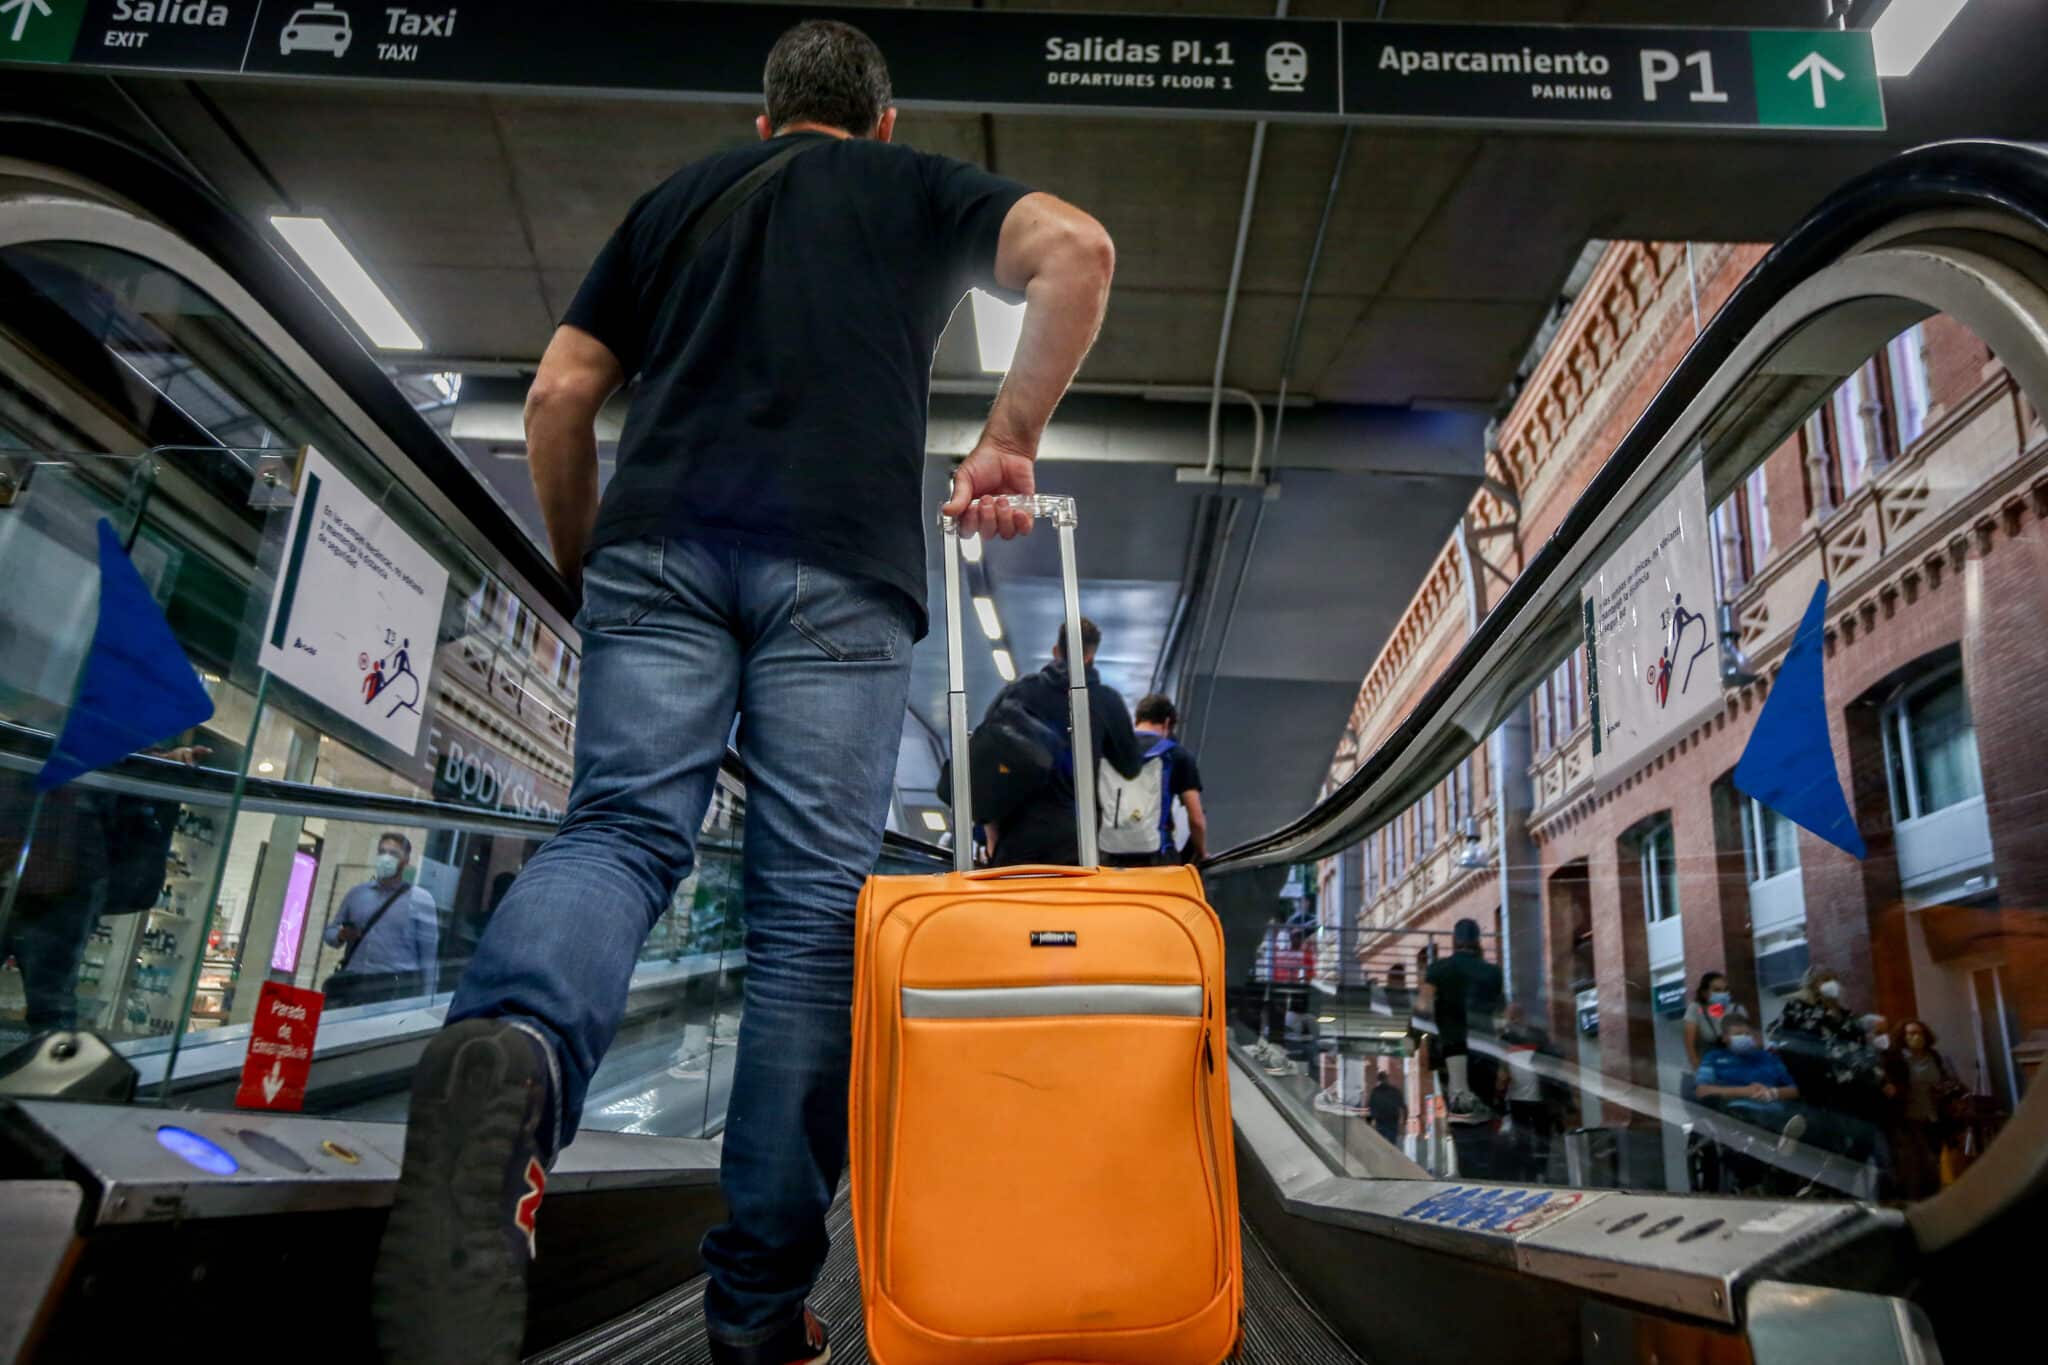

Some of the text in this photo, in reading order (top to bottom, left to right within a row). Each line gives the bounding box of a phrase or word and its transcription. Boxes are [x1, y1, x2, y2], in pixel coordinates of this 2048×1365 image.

[112, 0, 229, 26] Salida
[385, 8, 457, 38] Taxi
[104, 30, 149, 48] EXIT
[377, 43, 419, 61] TAXI
[1045, 37, 1234, 65] Salidas Pl.1
[1379, 45, 1610, 76] Aparcamiento
[1048, 72, 1233, 89] DEPARTURES FLOOR 1
[1639, 49, 1729, 103] P1
[1532, 83, 1612, 100] PARKING
[444, 741, 512, 811] BODY
[271, 999, 307, 1021] Parada
